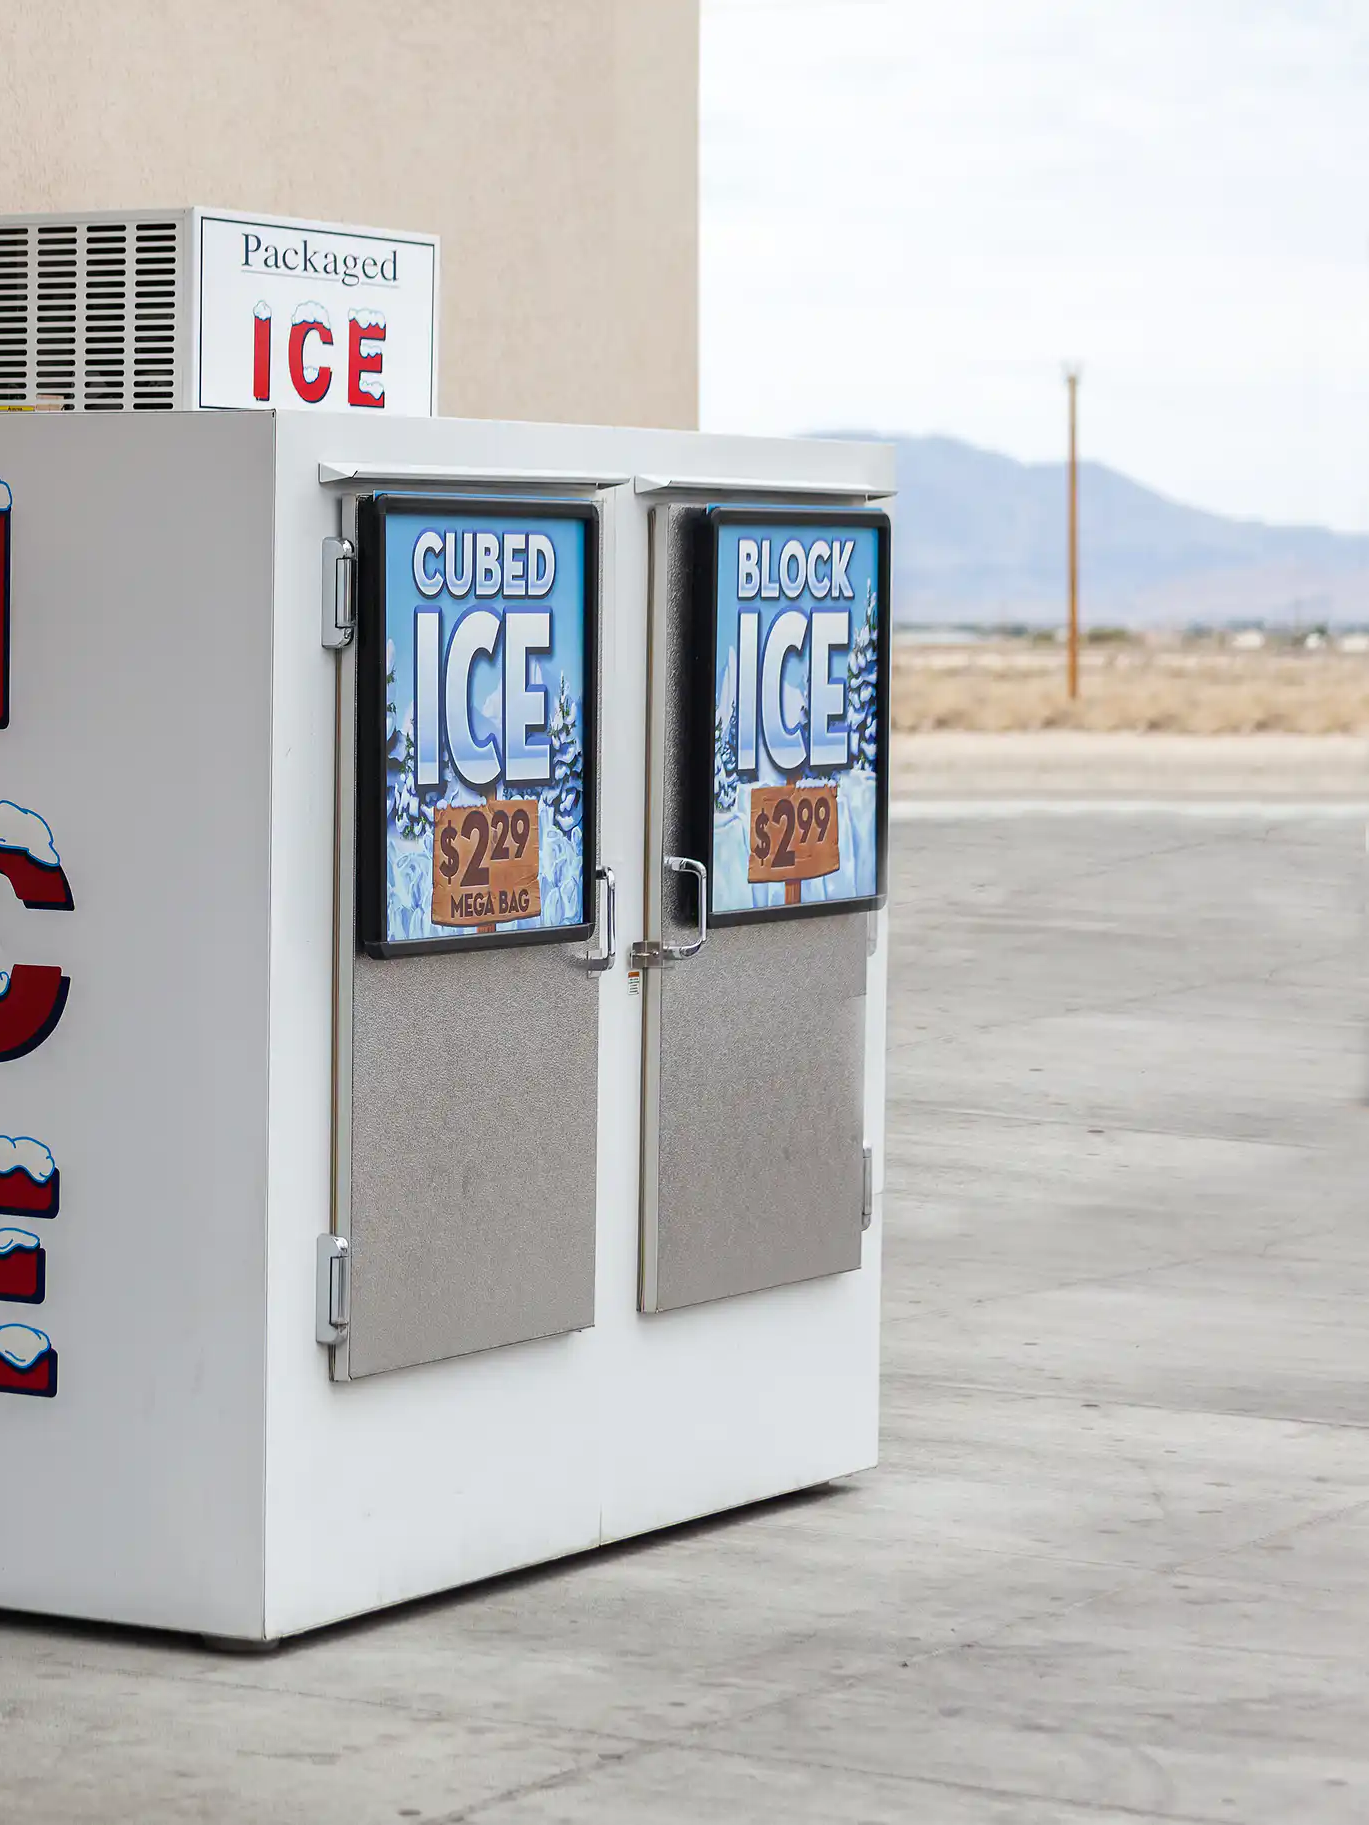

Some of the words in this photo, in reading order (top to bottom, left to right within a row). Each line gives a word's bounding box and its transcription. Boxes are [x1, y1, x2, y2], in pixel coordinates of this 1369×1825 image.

[242, 233, 400, 286] Packaged
[253, 300, 387, 408] ICE
[412, 528, 557, 600] CUBED
[736, 537, 855, 600] BLOCK
[414, 605, 553, 790] ICE
[736, 606, 851, 773] ICE
[451, 892, 495, 919] MEGA
[498, 888, 530, 915] BAG
